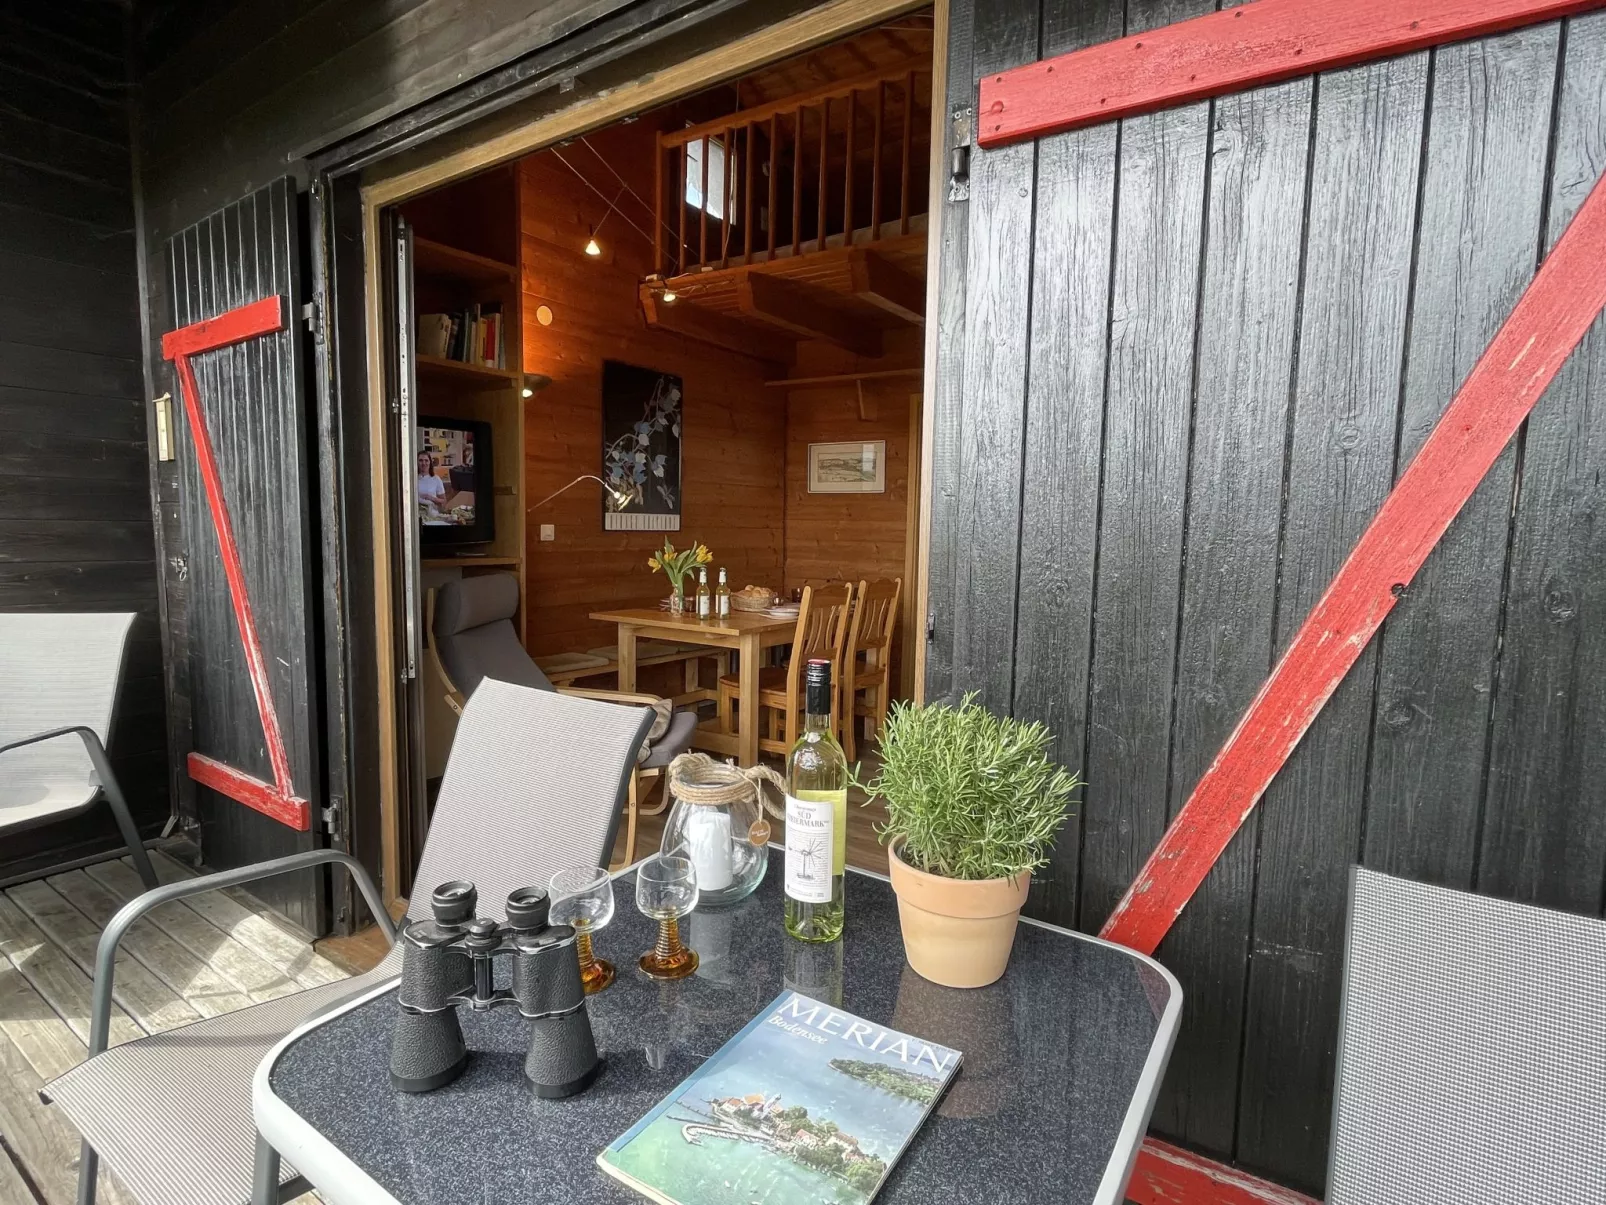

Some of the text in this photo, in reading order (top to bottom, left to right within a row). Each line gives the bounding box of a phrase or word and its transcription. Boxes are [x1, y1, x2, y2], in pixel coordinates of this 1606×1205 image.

[797, 810, 811, 820] SÜD
[768, 1015, 828, 1045] Bodensee
[778, 998, 953, 1073] MERIAN
